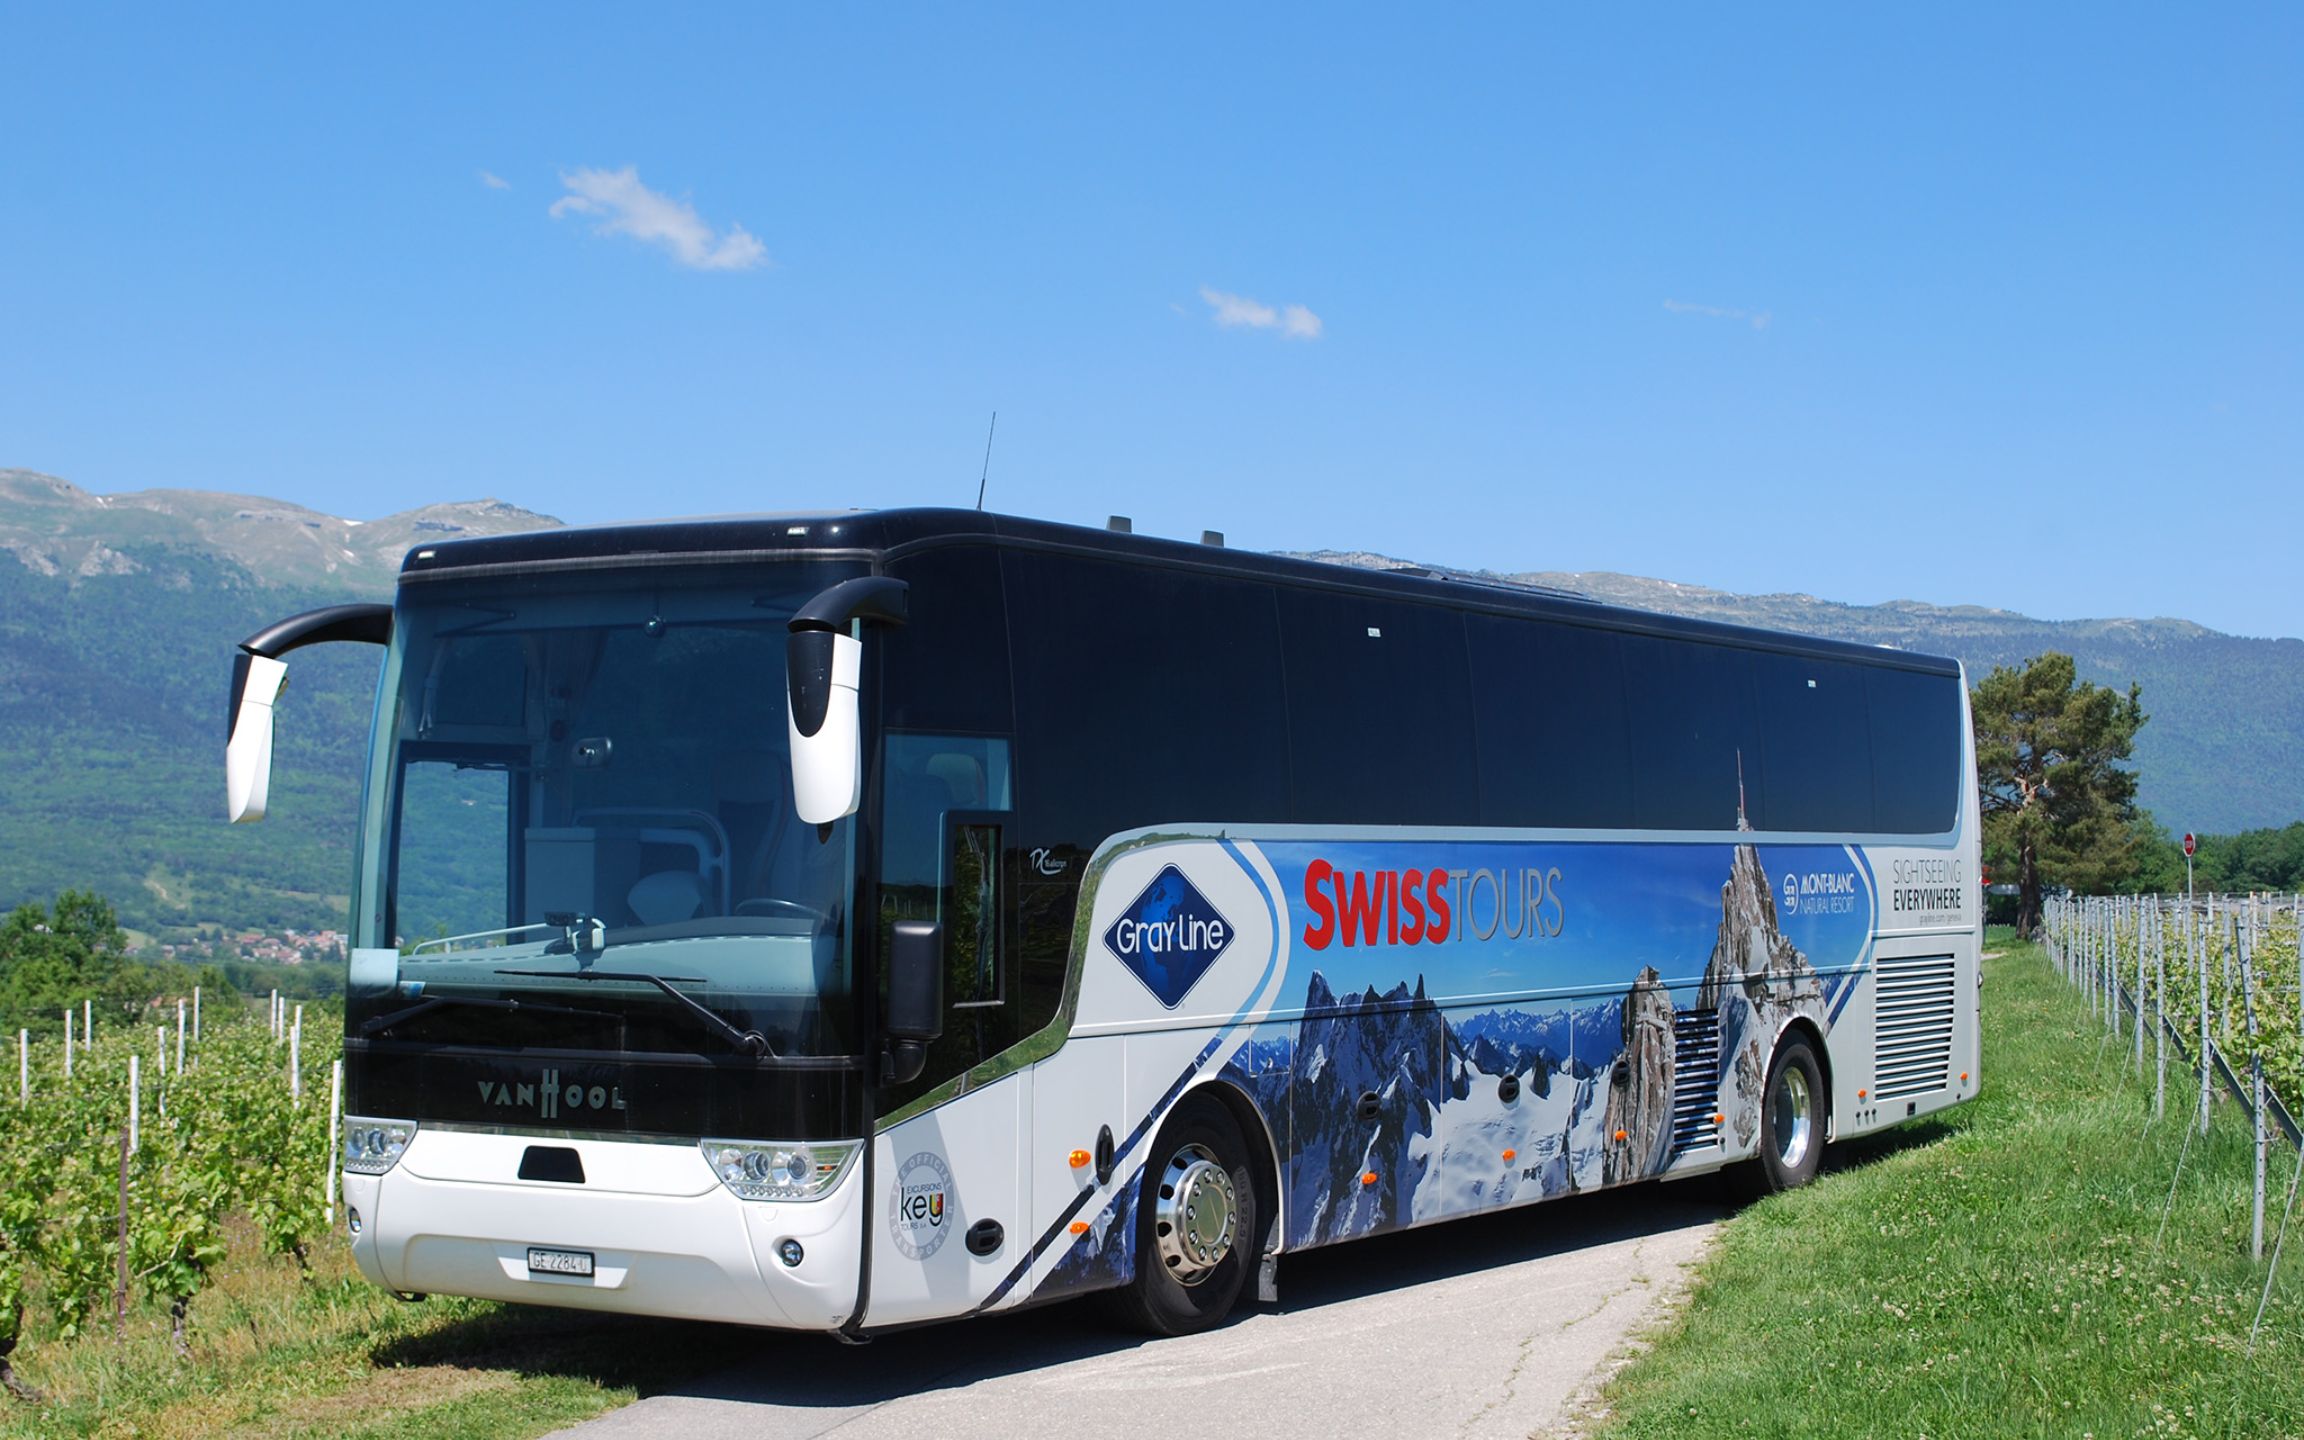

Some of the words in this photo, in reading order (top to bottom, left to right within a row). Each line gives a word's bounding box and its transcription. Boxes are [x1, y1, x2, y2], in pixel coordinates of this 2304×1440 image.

[1893, 859, 1962, 884] SIGHTSEEING
[1800, 872, 1855, 894] MONT-BLANC
[1800, 897, 1829, 915] NATURAL
[1831, 896, 1855, 913] RESORT
[1893, 888, 1962, 911] EVERYWHERE
[906, 1182, 942, 1195] EXCURSIONS
[900, 1186, 944, 1227] key
[900, 1221, 919, 1231] TOURS
